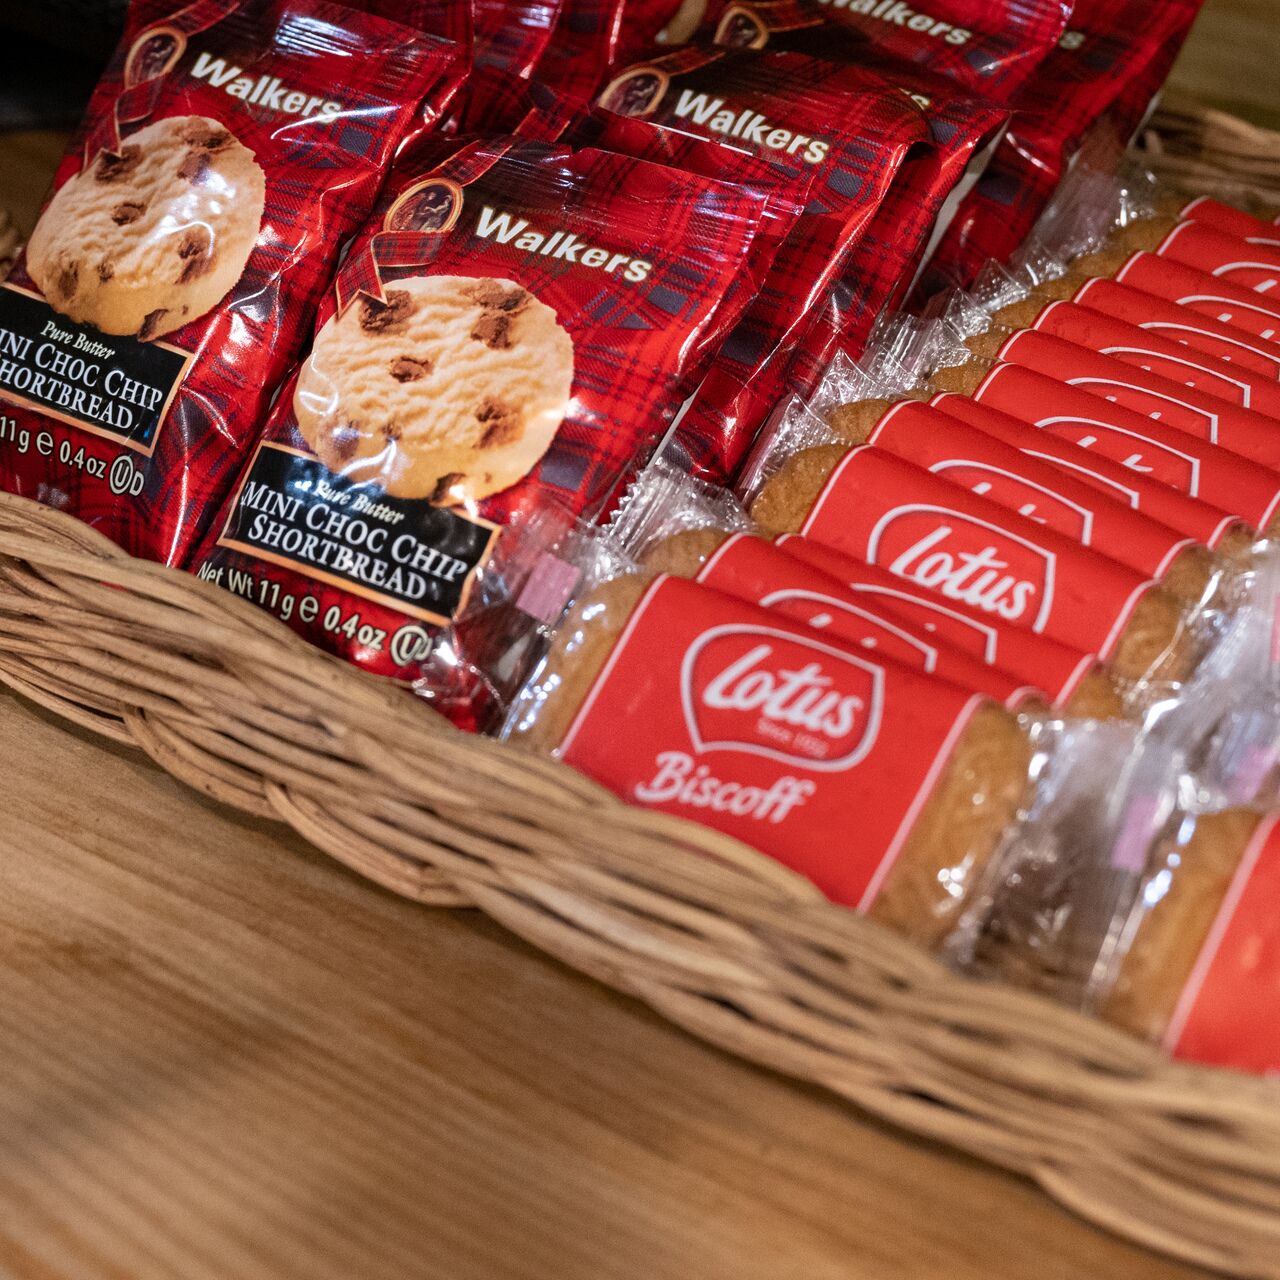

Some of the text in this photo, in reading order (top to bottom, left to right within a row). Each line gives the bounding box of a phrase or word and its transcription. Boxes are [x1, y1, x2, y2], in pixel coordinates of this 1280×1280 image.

[190, 52, 342, 124] Walkers
[674, 89, 829, 163] Walkers
[475, 206, 652, 283] Walkers
[40, 320, 115, 360] Pure Butter
[35, 343, 99, 387] CHOC
[105, 370, 163, 411] CHIP
[240, 481, 468, 582] MINI CHOC CHIP
[313, 479, 405, 524] Pure Butter
[228, 568, 253, 599] Wt
[248, 514, 427, 600] SHORTBREAD
[889, 525, 1035, 619] Lotus
[702, 644, 864, 736] Lotus
[634, 751, 816, 823] Biscoff
